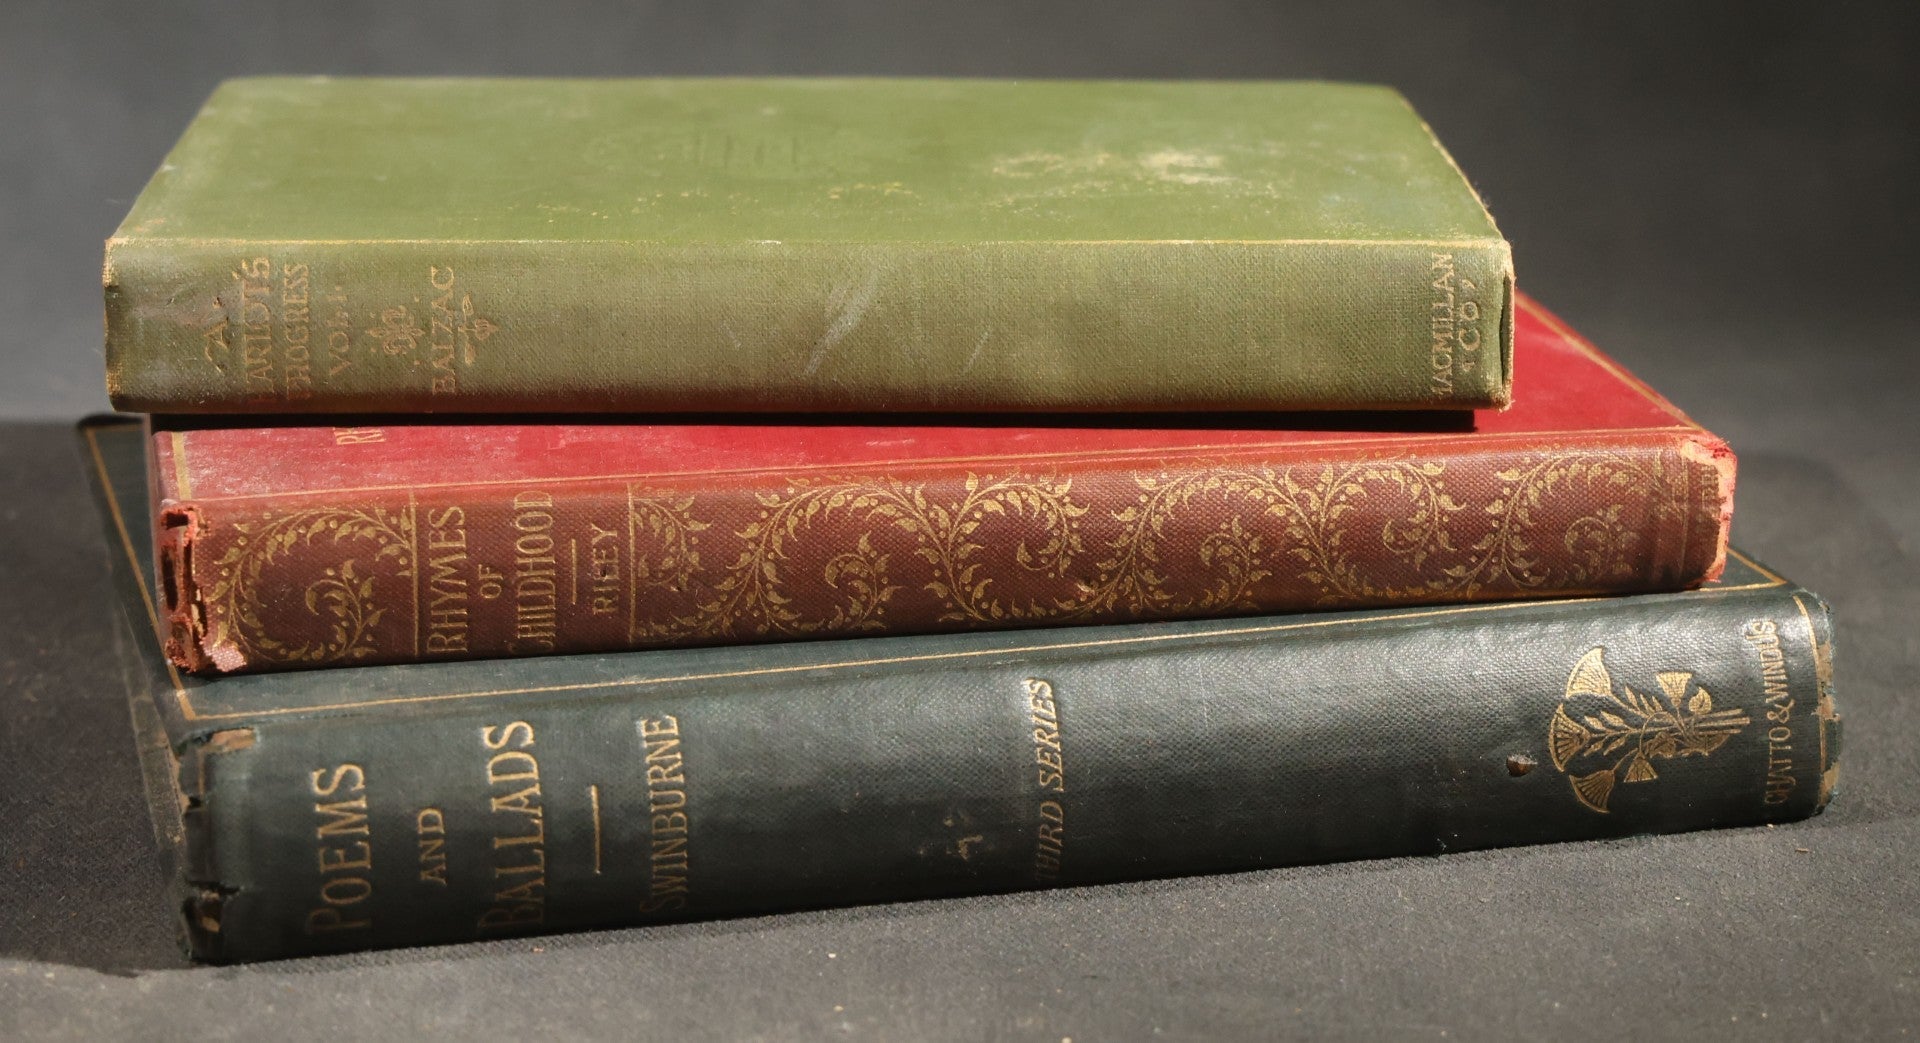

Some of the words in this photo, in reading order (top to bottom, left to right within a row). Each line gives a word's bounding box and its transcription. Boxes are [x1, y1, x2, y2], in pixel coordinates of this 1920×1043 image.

[431, 266, 456, 395] BALZAC
[426, 505, 469, 653] RHYMES
[478, 563, 504, 600] OF
[590, 522, 621, 616] RILEY
[1745, 620, 1790, 704] WINDUS
[1022, 676, 1066, 793] SERIES
[1765, 698, 1796, 724] &
[1763, 726, 1797, 805] CHATTO
[305, 763, 373, 936] POEMS
[416, 807, 448, 888] AND
[477, 719, 546, 931] BALLADS
[636, 714, 690, 914] SWINBURNE
[1033, 799, 1065, 882] THIRD
